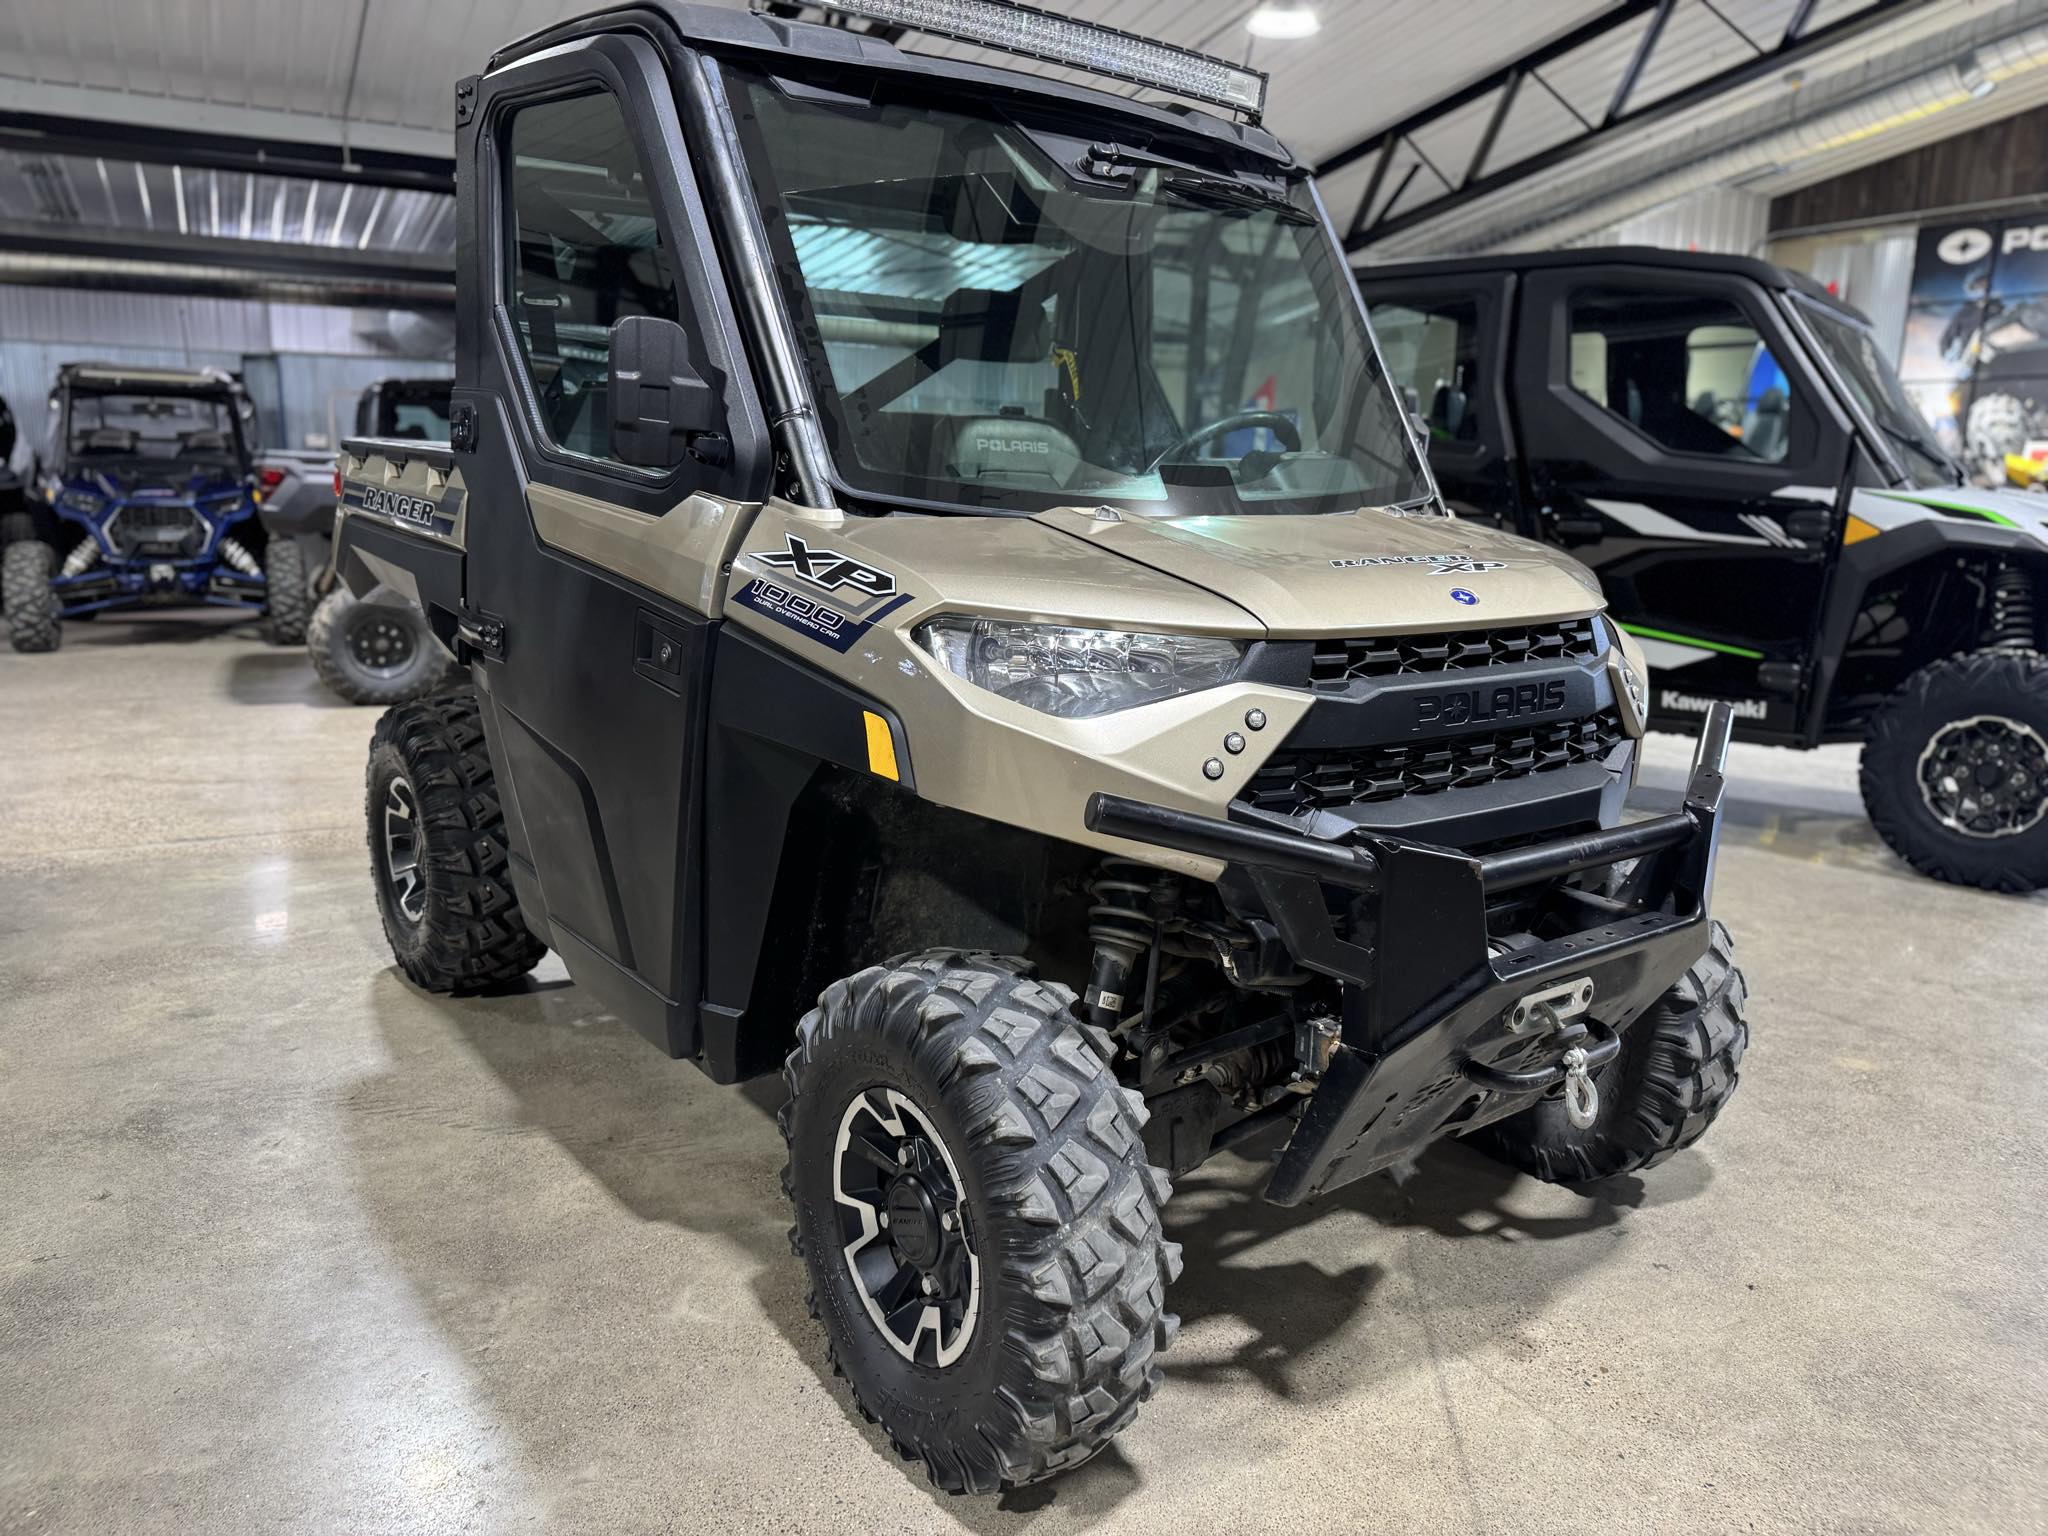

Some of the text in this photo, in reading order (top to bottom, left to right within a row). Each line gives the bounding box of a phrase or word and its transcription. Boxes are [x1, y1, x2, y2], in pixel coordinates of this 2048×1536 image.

[976, 438, 1048, 454] POLARIS
[362, 486, 435, 526] RANGER
[748, 531, 897, 597] XP
[1329, 555, 1473, 568] RANGER
[1426, 561, 1509, 576] XP
[750, 577, 846, 631] 1000
[753, 597, 841, 640] DUAL OVERHEAD CAM
[1411, 679, 1566, 732] POLARIS
[1661, 690, 1767, 719] Kawaki
